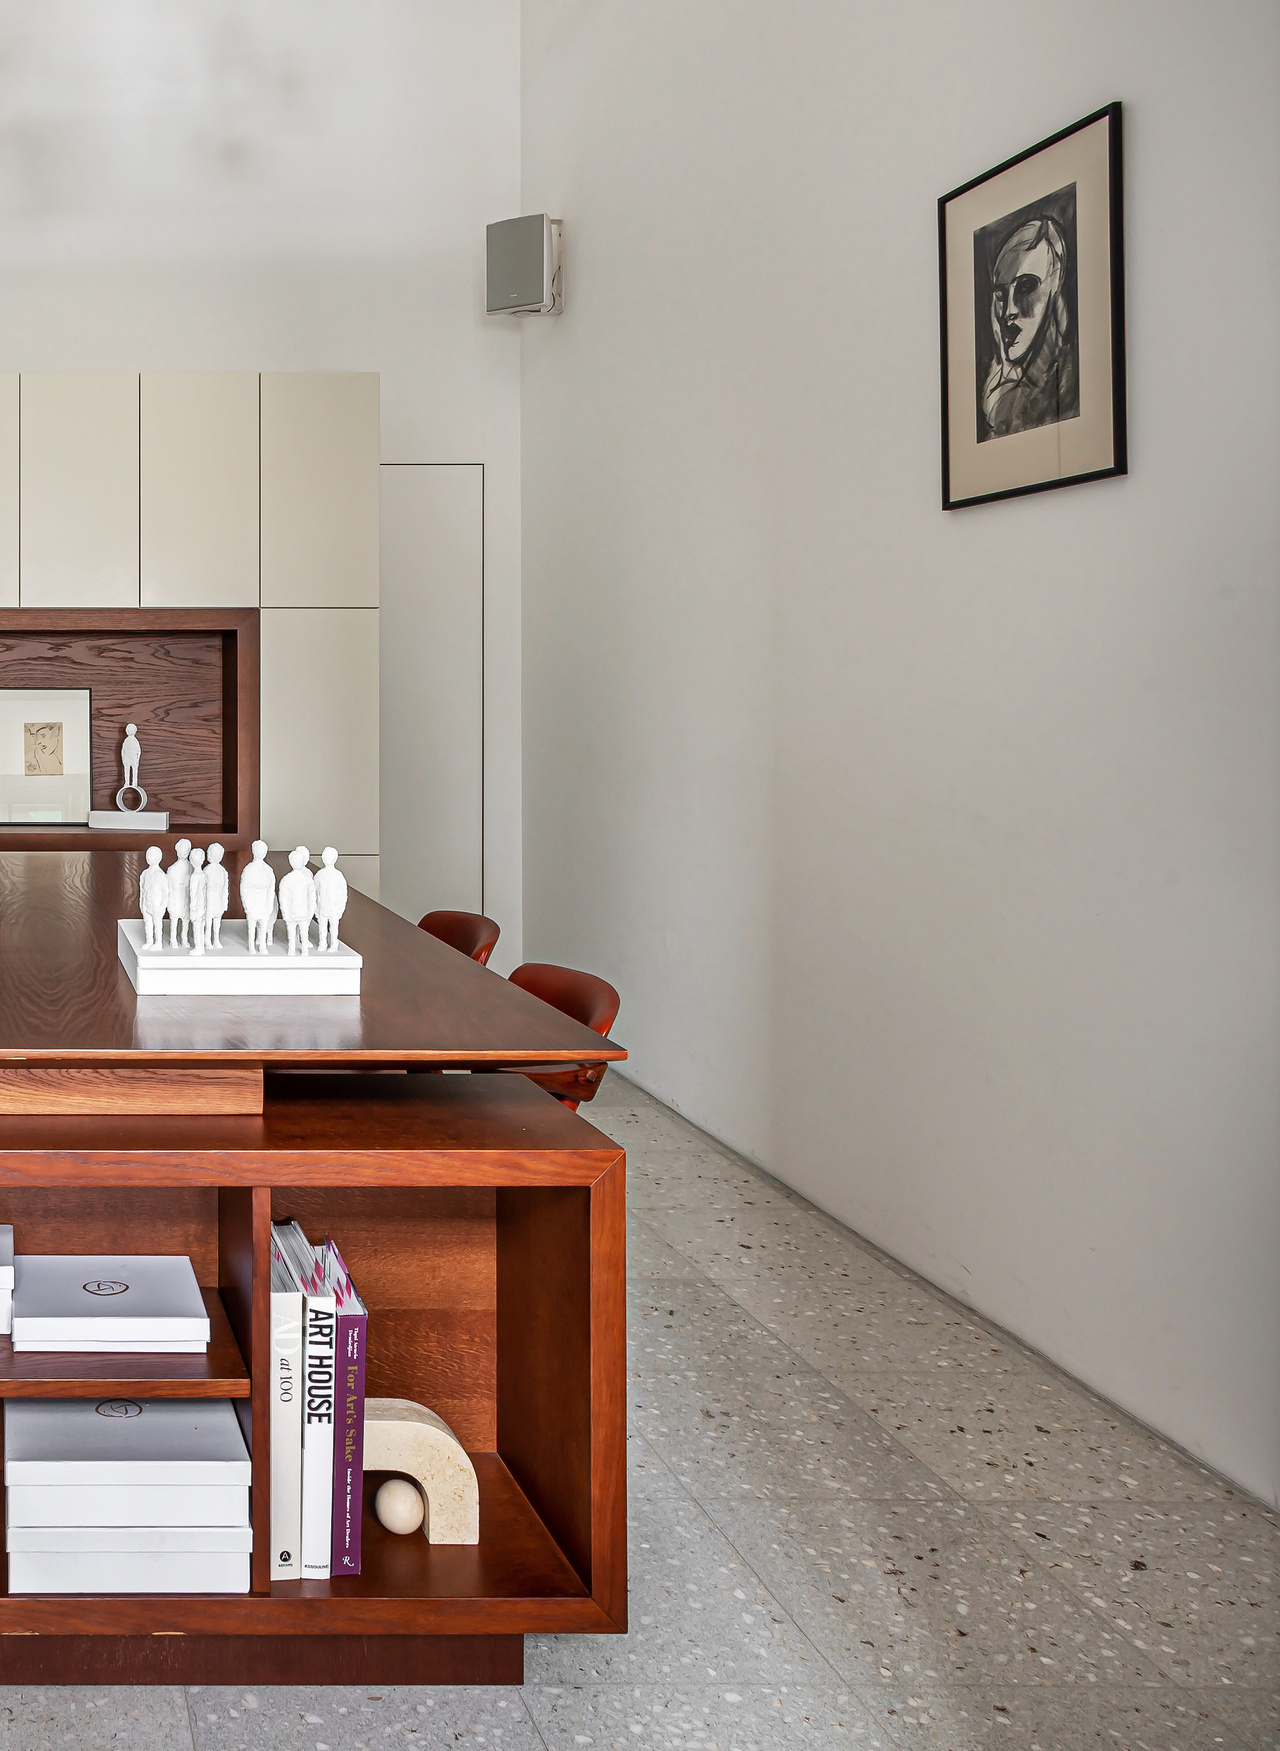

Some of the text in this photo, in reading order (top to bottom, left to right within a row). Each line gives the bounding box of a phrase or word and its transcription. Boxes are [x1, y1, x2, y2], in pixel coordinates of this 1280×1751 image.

[274, 1313, 301, 1402] AD at 100
[306, 1308, 334, 1424] ART HOUSE
[345, 1366, 358, 1462] For Art's Sake
